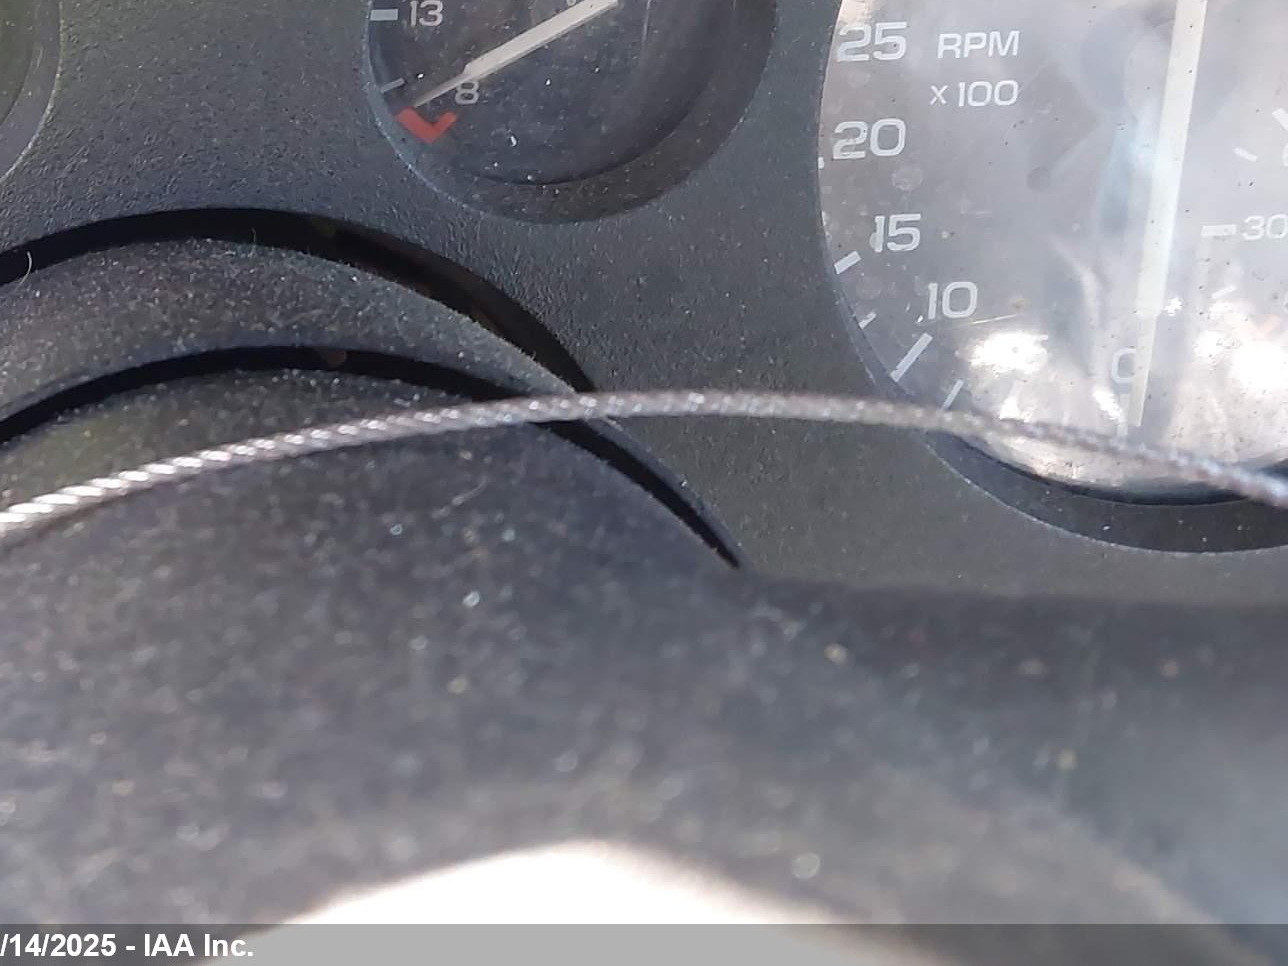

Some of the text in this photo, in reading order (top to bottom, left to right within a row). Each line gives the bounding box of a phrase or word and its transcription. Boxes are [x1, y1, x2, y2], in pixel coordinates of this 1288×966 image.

[410, 0, 443, 26] 13
[836, 21, 908, 63] 25
[936, 30, 1020, 59] RPM
[455, 81, 480, 106] 8
[958, 80, 1019, 107] 100
[832, 118, 906, 160] 20
[874, 214, 921, 253] 15
[1242, 214, 1288, 240] 30
[927, 281, 978, 320] 10
